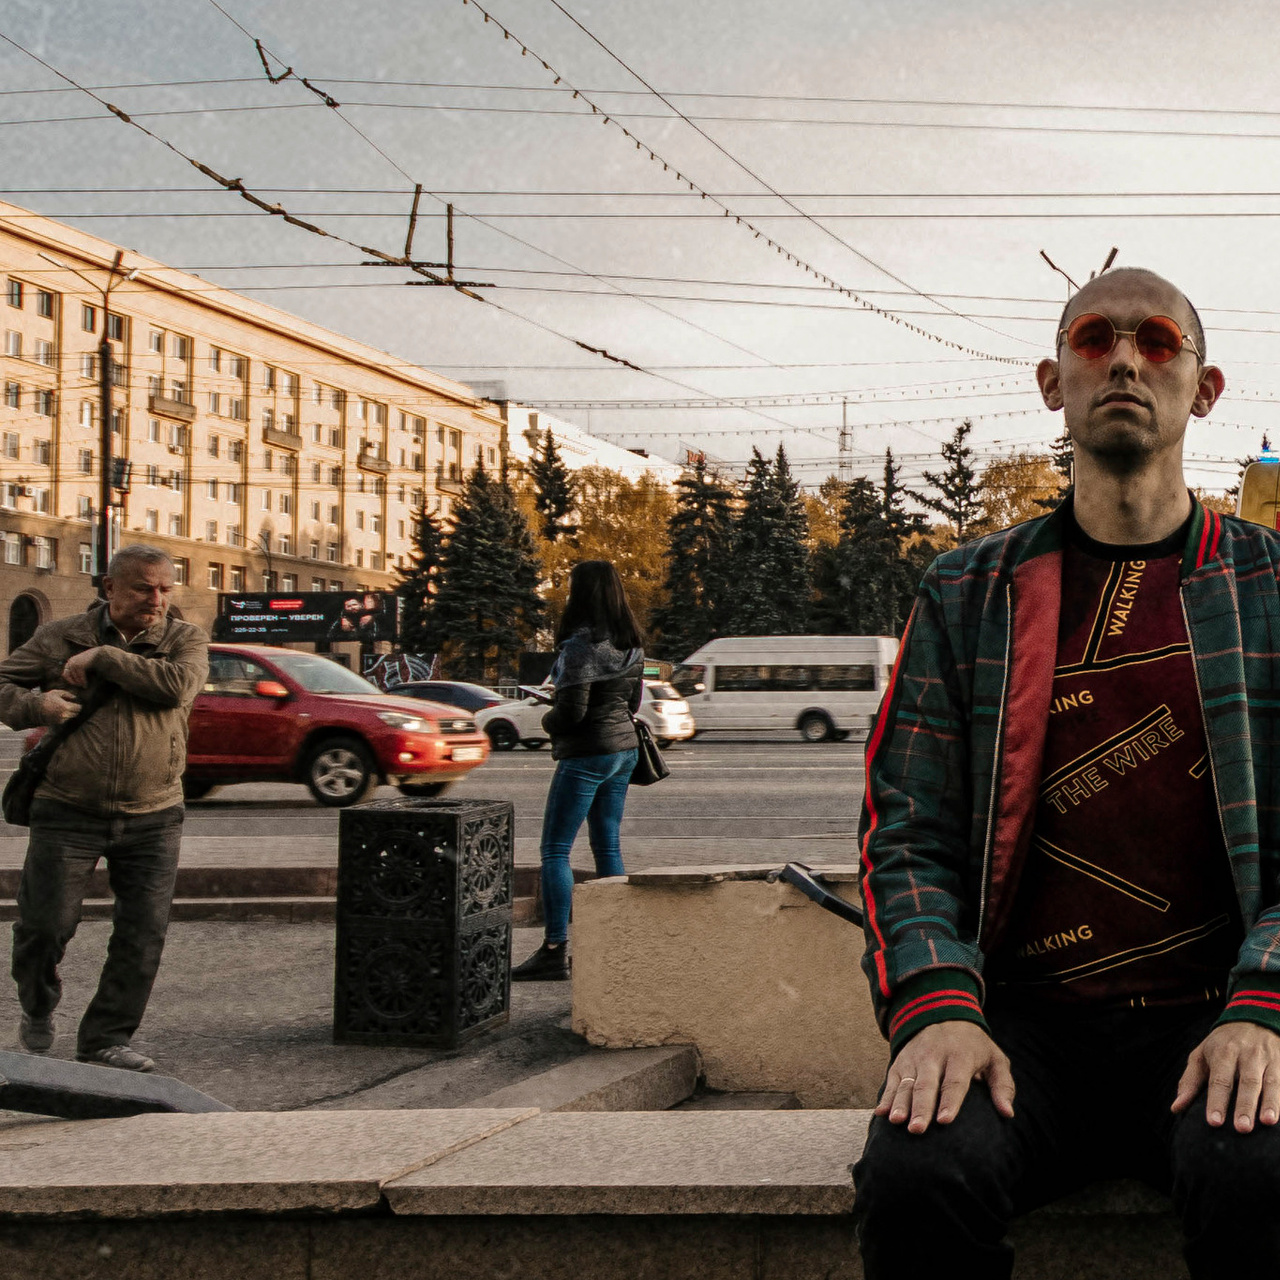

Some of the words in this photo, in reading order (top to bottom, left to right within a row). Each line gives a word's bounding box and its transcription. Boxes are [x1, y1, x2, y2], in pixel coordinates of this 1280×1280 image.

[230, 614, 279, 622] ПРОВЕРЕН
[288, 613, 325, 621] УВЕРЕН
[1107, 560, 1147, 636] WALKING
[1046, 766, 1110, 815] THE
[1102, 716, 1185, 776] WIRE
